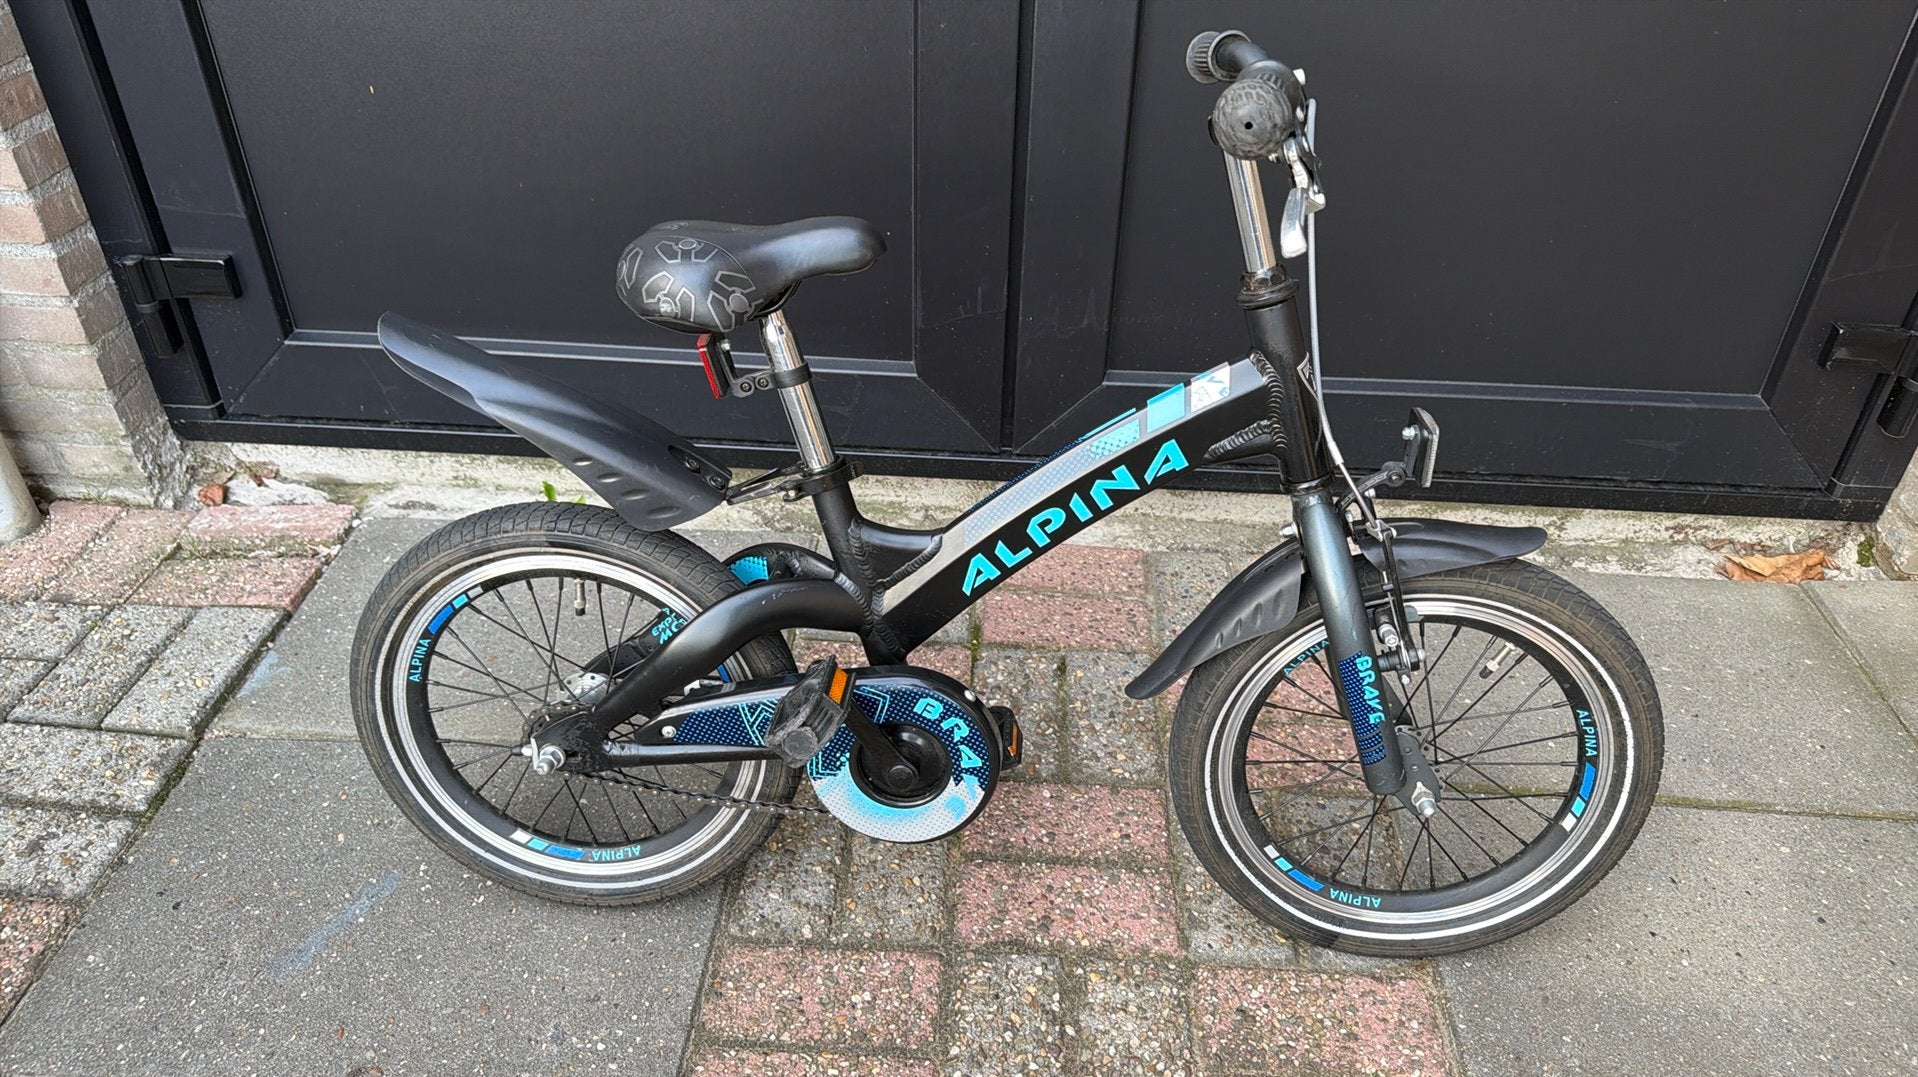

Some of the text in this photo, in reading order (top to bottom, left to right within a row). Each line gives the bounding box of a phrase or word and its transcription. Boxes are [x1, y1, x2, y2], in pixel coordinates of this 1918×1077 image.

[961, 438, 1190, 597] ALPINA
[408, 639, 432, 682] ALPINA
[1283, 640, 1329, 675] ALPINA
[1355, 656, 1386, 725] BRAVE
[1576, 709, 1598, 757] ALPINA
[591, 844, 641, 861] ALPINA
[1329, 887, 1382, 908] ALPINA
